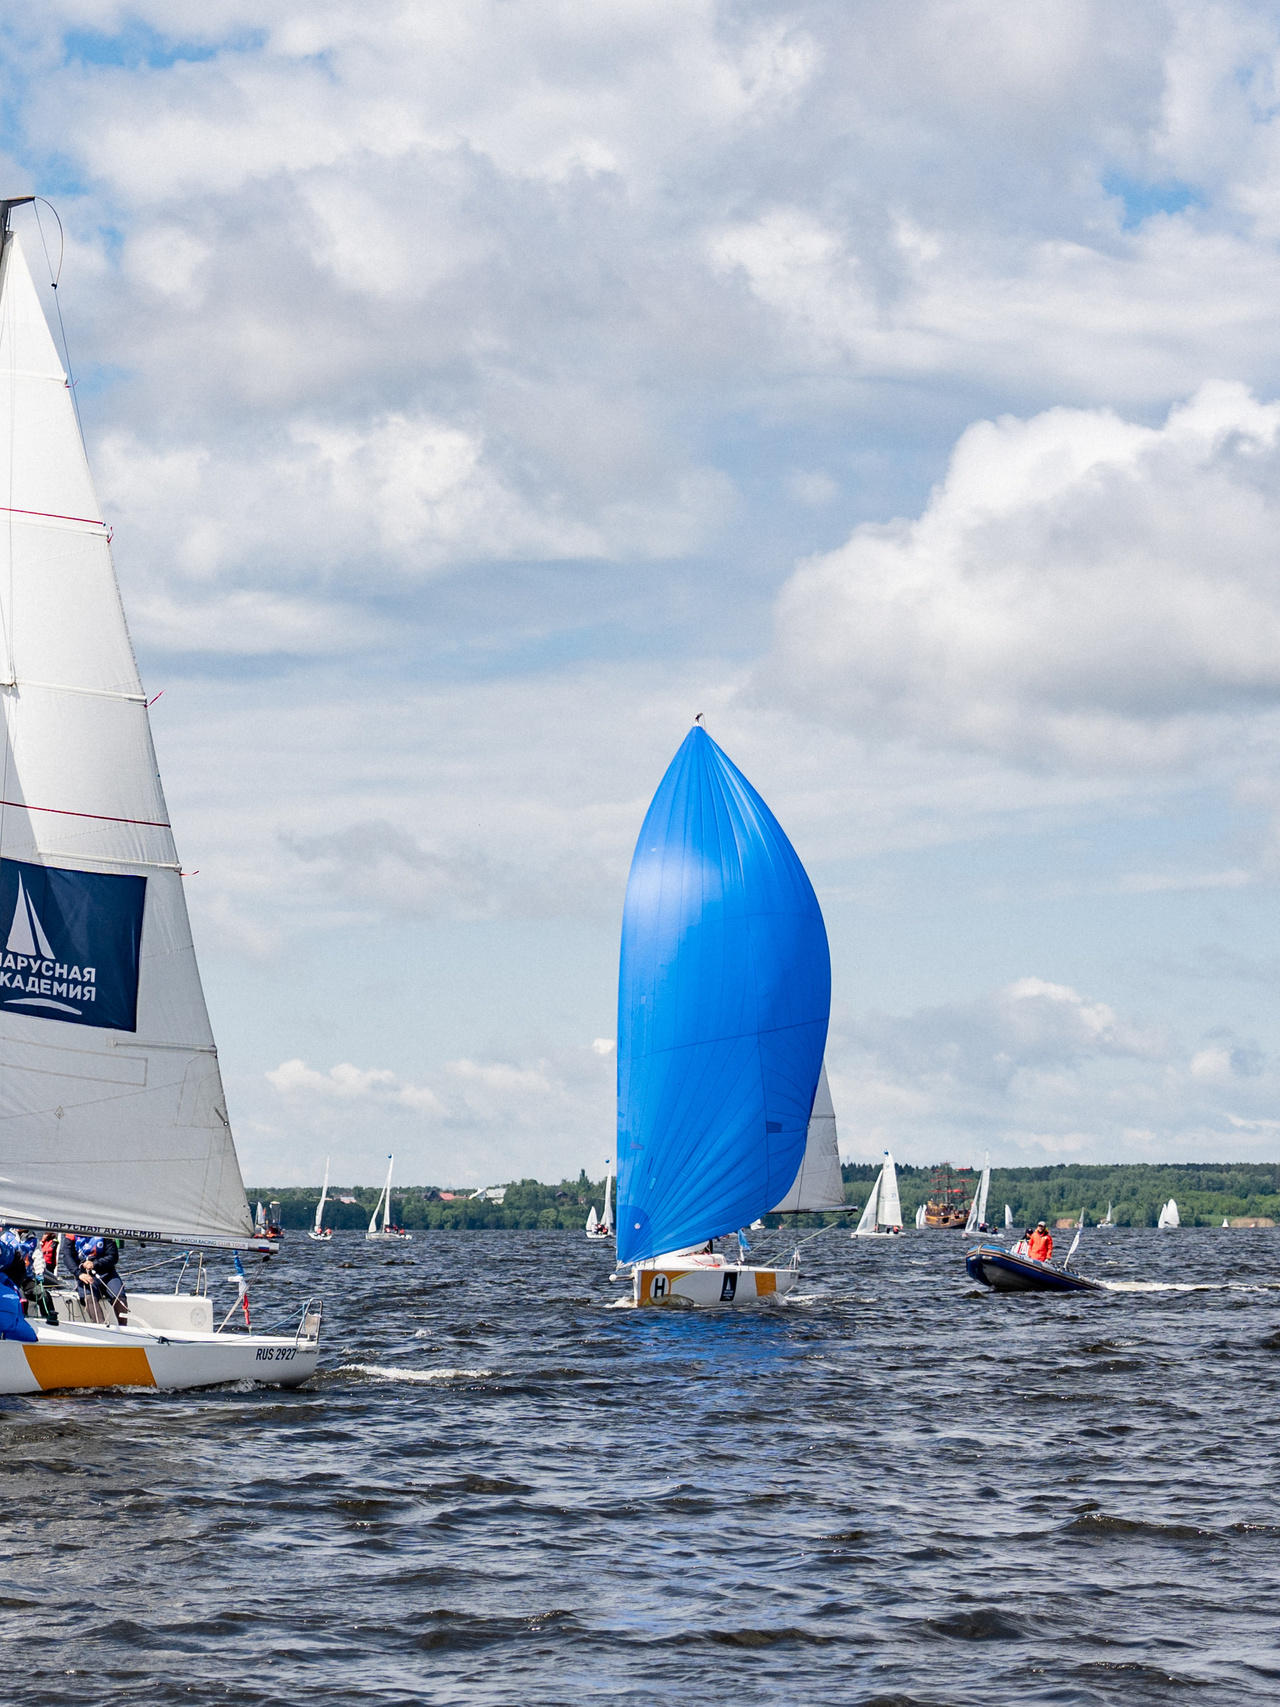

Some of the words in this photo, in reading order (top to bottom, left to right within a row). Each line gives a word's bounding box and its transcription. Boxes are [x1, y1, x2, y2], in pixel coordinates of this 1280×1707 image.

[45, 1221, 101, 1233] ПАРУСНАЯ
[104, 1228, 162, 1240] АКАДЕМИЯ
[654, 1277, 666, 1299] H
[255, 1348, 274, 1361] RUS
[275, 1348, 297, 1361] 2927
